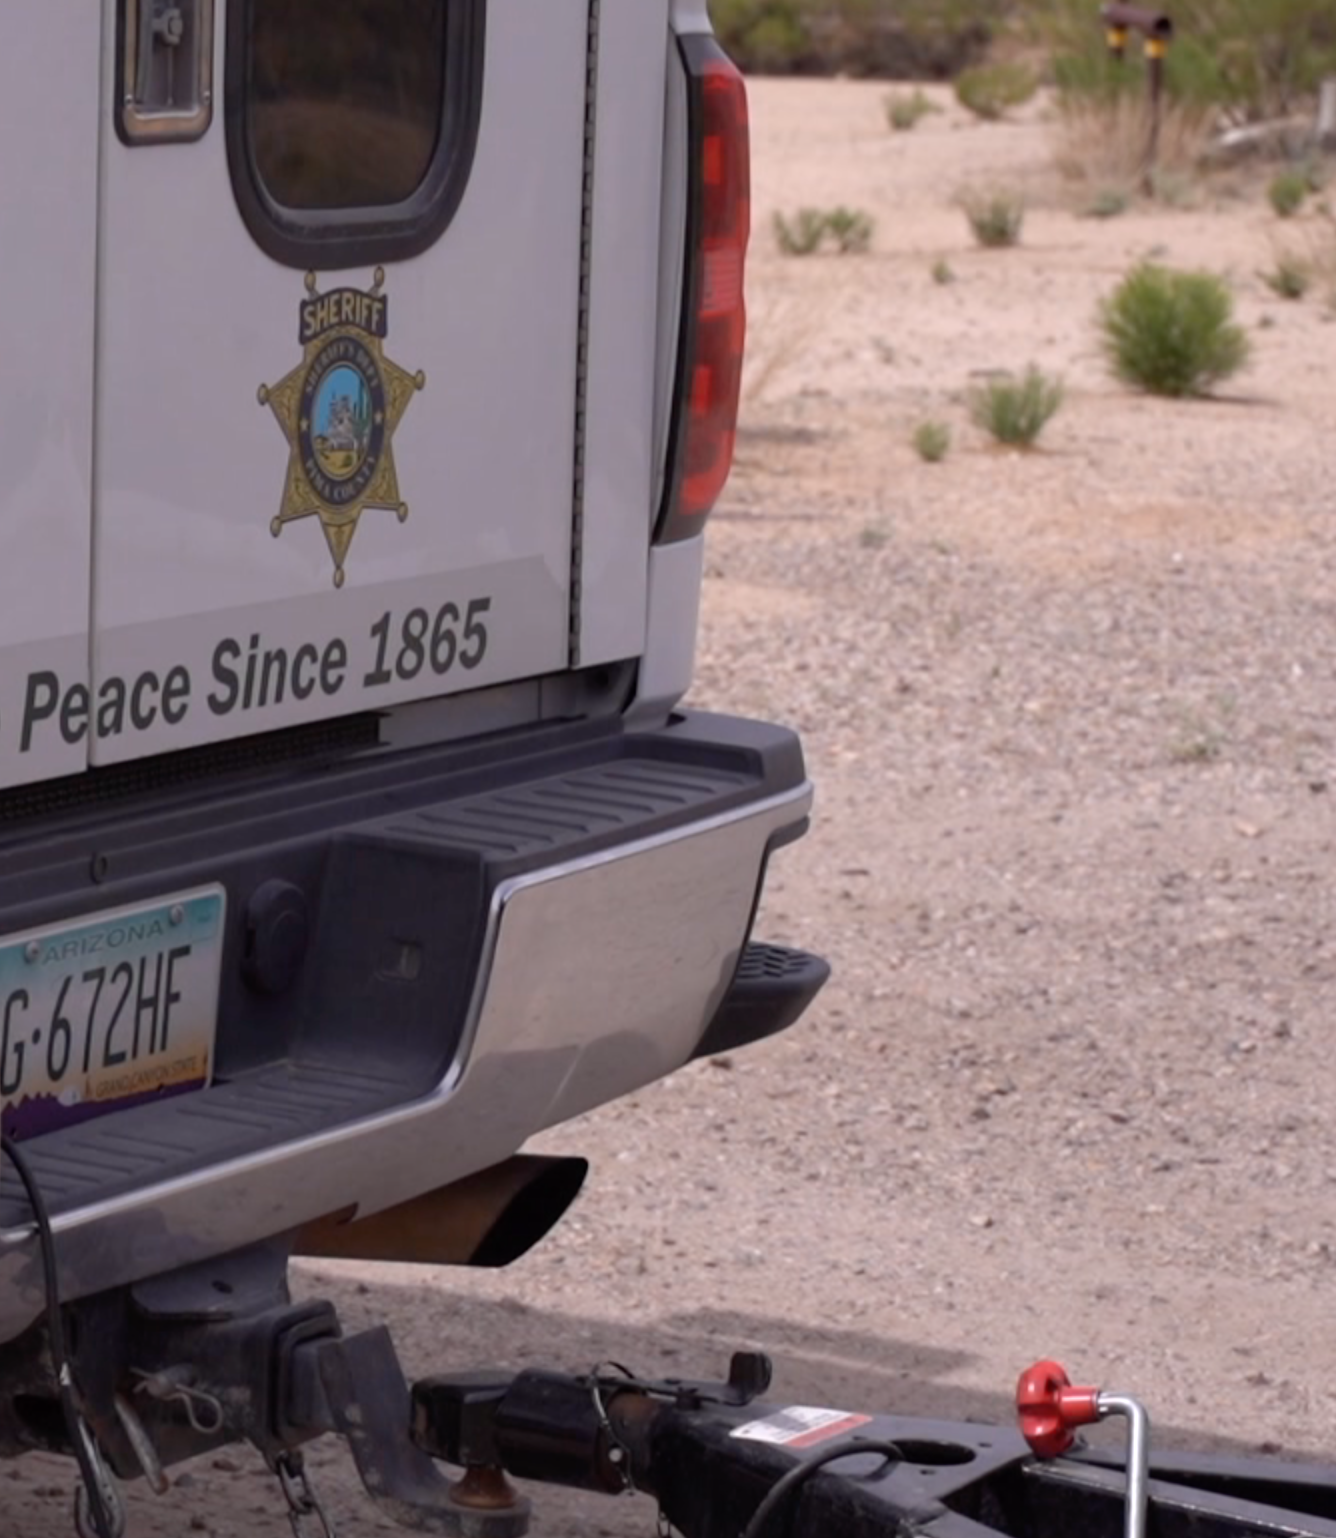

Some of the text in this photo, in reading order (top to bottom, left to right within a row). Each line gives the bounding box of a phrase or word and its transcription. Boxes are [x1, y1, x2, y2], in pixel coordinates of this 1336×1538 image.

[303, 290, 384, 336] SHERIFF
[19, 670, 192, 754] Peace
[206, 633, 348, 717] Since
[362, 596, 492, 689] 1865
[42, 918, 164, 966] ARIZONA
